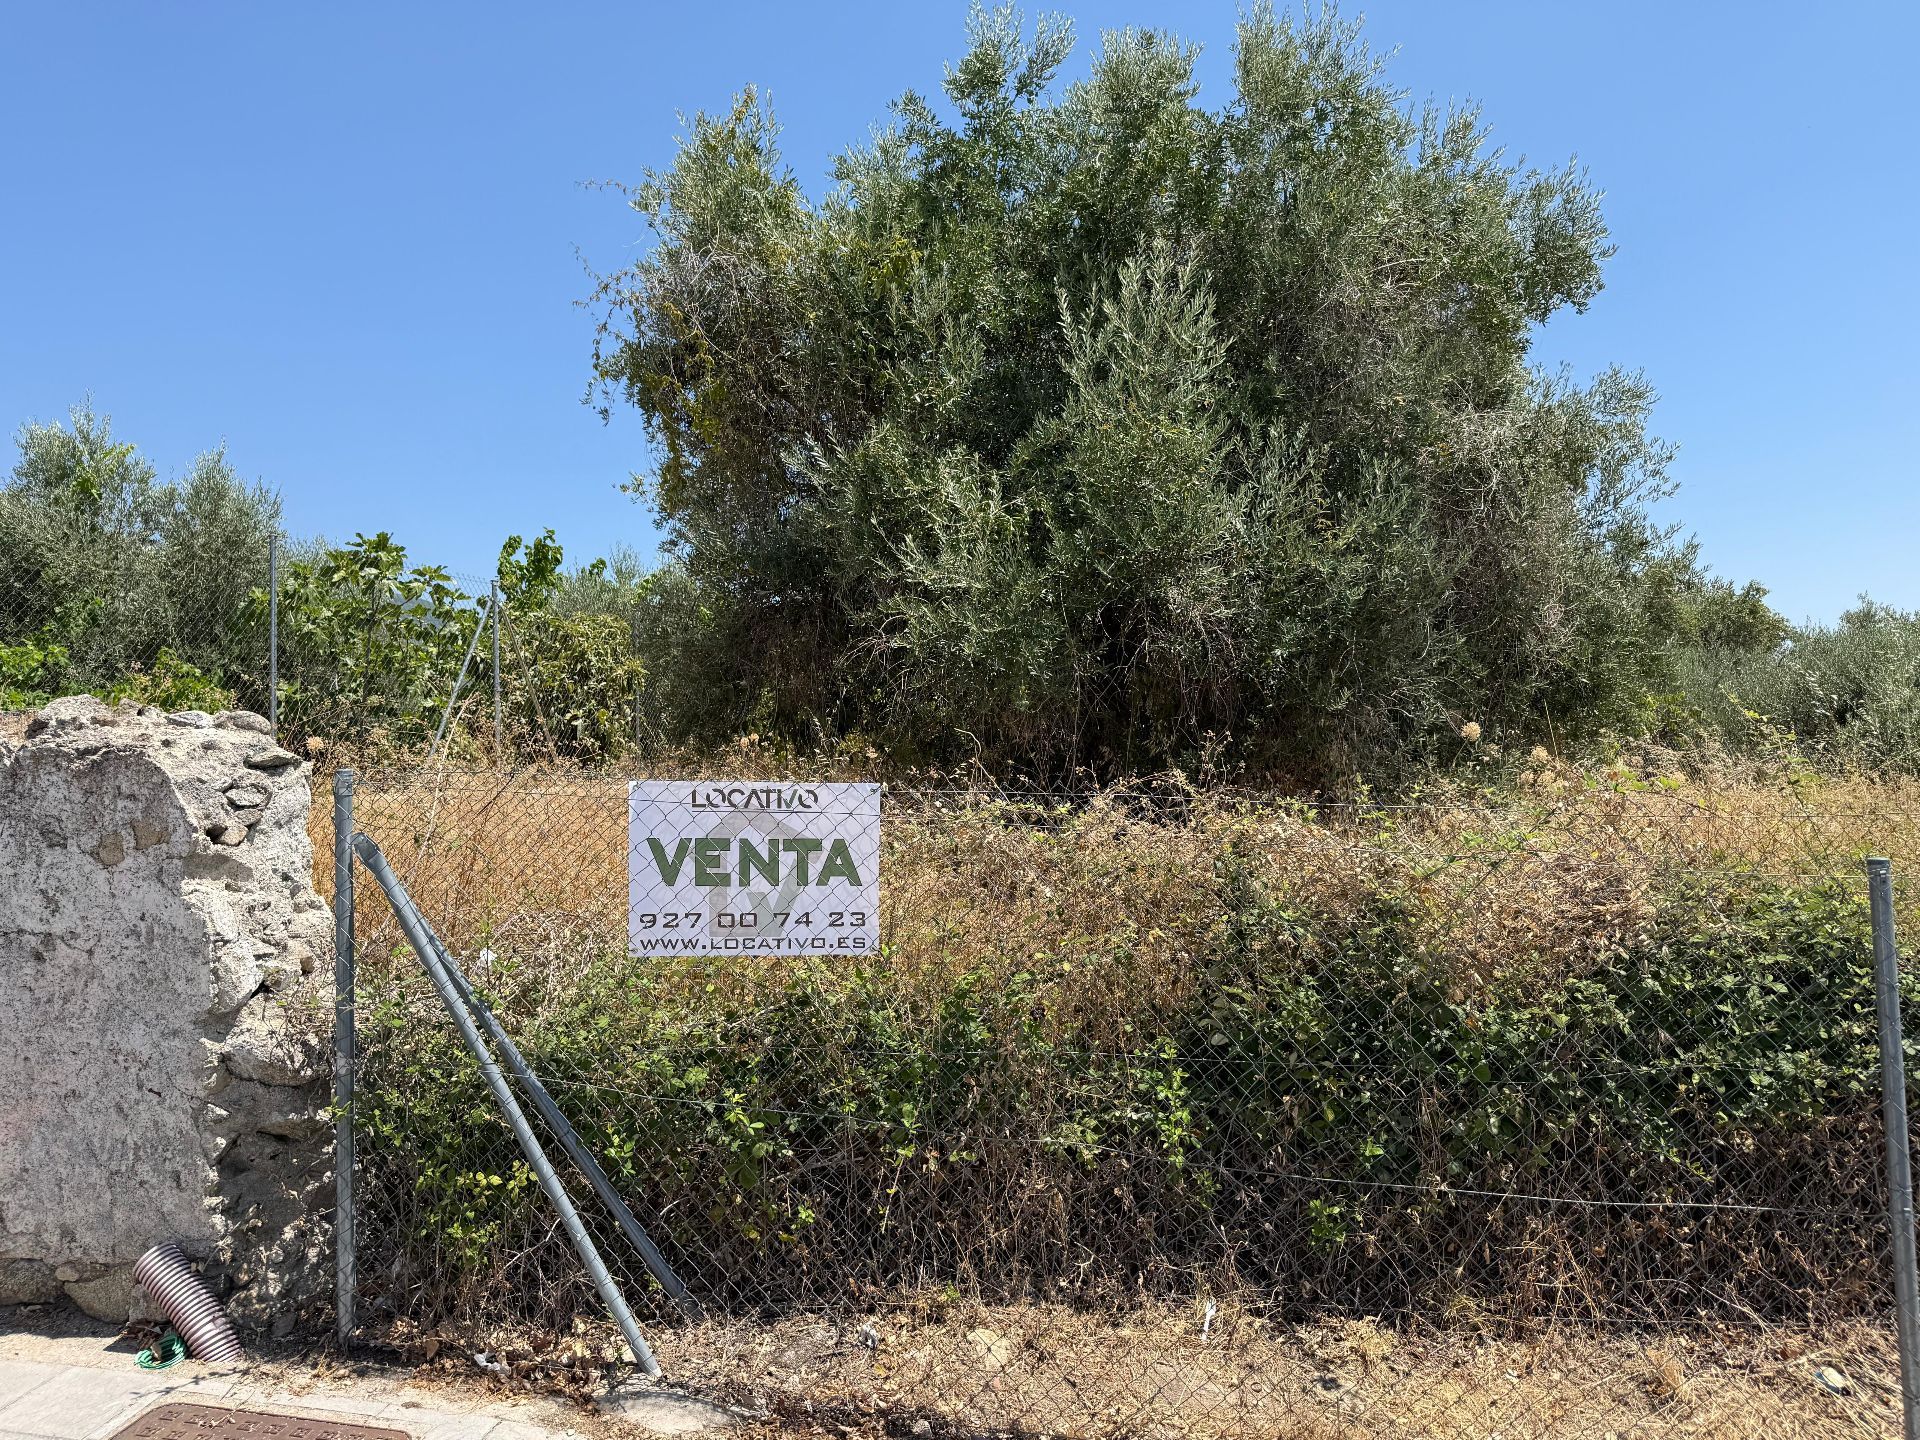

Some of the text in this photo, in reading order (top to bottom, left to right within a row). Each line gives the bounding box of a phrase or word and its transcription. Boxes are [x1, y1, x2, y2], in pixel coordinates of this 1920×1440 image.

[691, 788, 819, 809] LOCATIVO
[646, 837, 863, 887] VENTA
[639, 911, 866, 929] 927 00 74 23
[639, 937, 866, 951] WWW.LOCATIVO.ES
